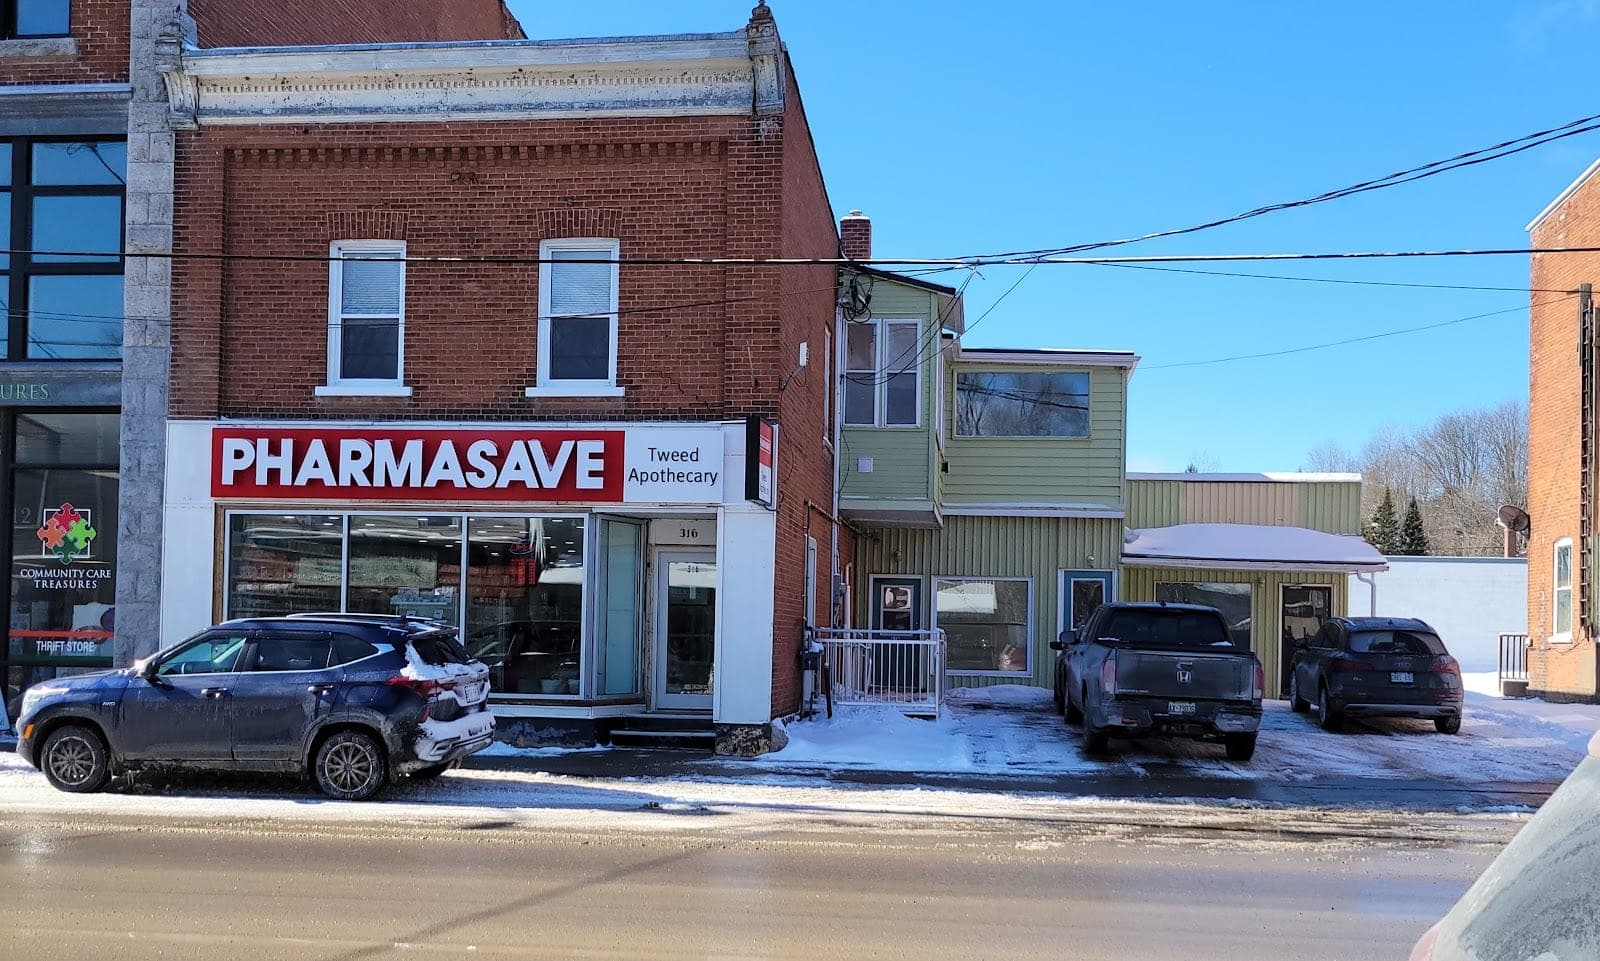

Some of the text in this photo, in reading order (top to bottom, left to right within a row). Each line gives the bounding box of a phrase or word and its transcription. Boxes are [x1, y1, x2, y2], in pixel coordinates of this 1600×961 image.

[648, 446, 700, 463] Tweed
[221, 438, 605, 488] PHARMASAVE
[628, 467, 719, 486] Apothecary
[680, 528, 698, 539] 316
[20, 568, 112, 580] COMMUNITY CARE
[34, 579, 98, 590] TREASURES
[36, 640, 95, 653] THRIFT STORE
